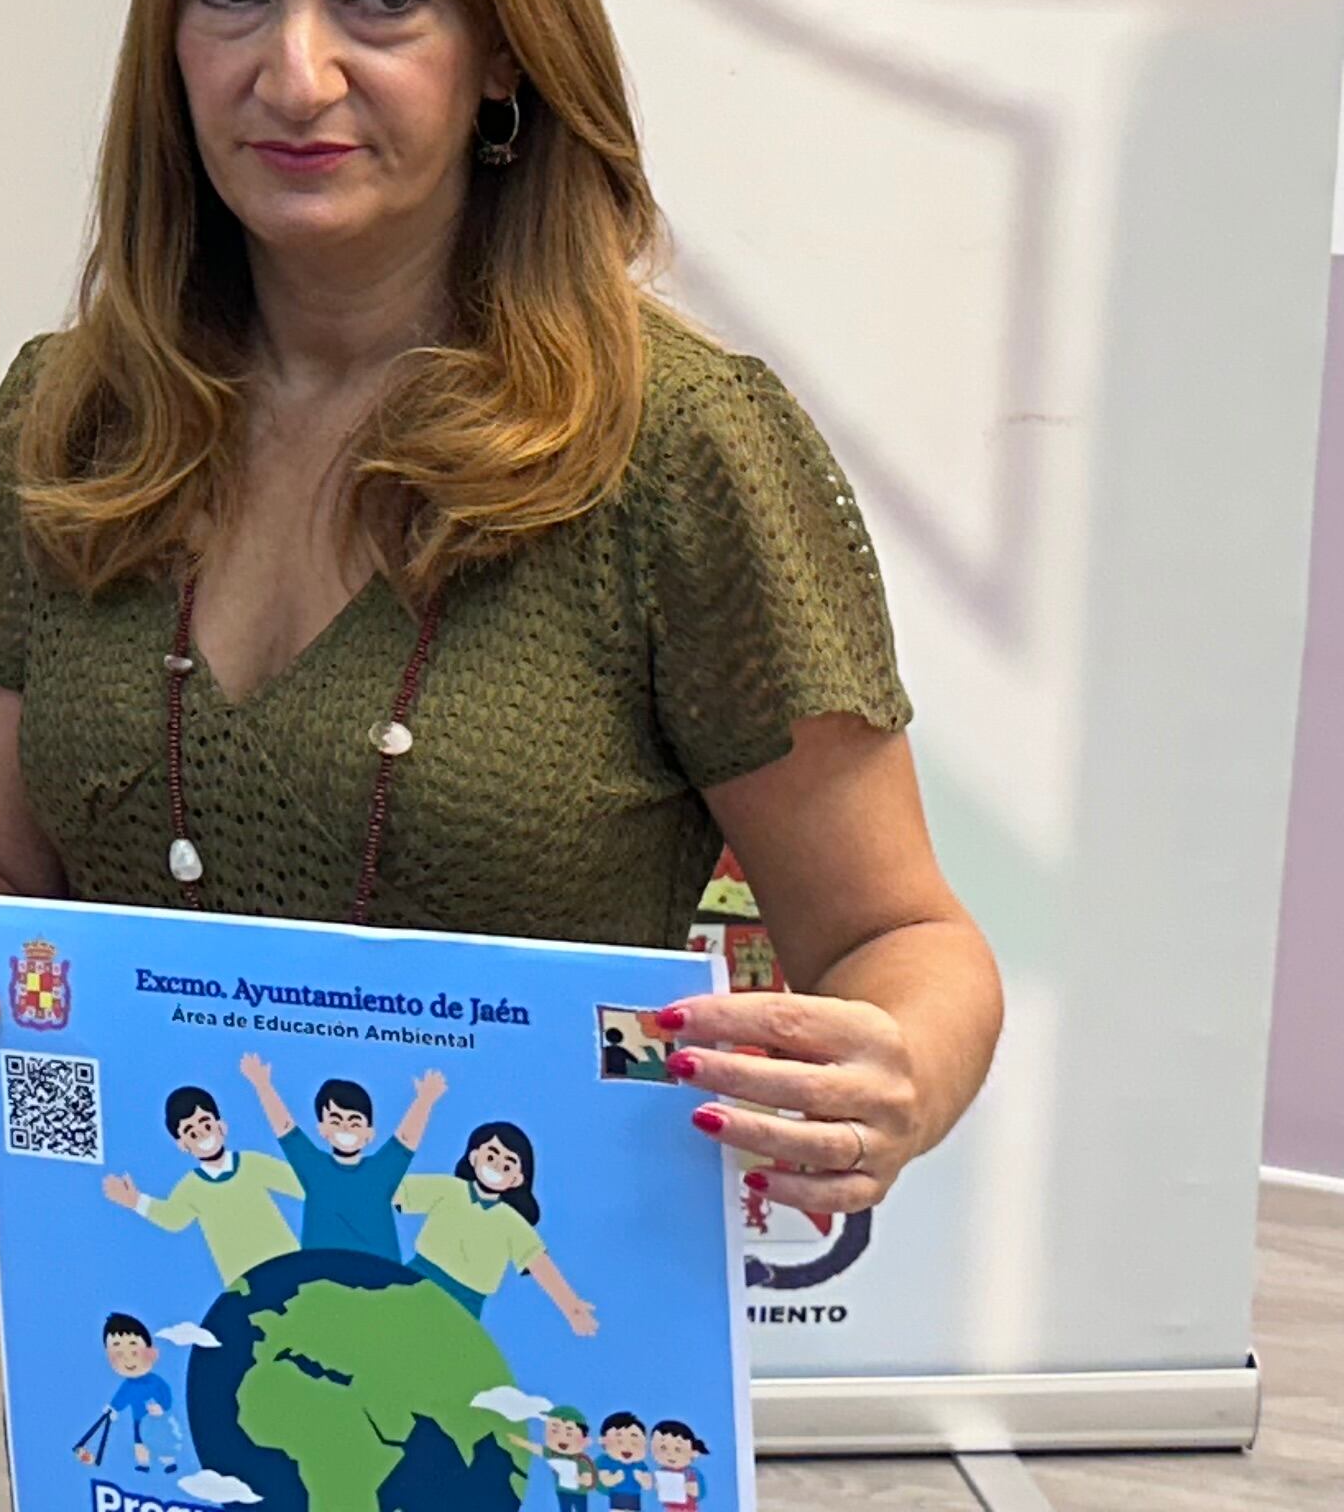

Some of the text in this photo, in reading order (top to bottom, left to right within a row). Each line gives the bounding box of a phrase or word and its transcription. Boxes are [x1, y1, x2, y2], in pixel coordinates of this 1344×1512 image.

[135, 969, 531, 1026] Excmo. Ayuntamiento de Jaén
[171, 1003, 476, 1050] Área de Educación Ambiental
